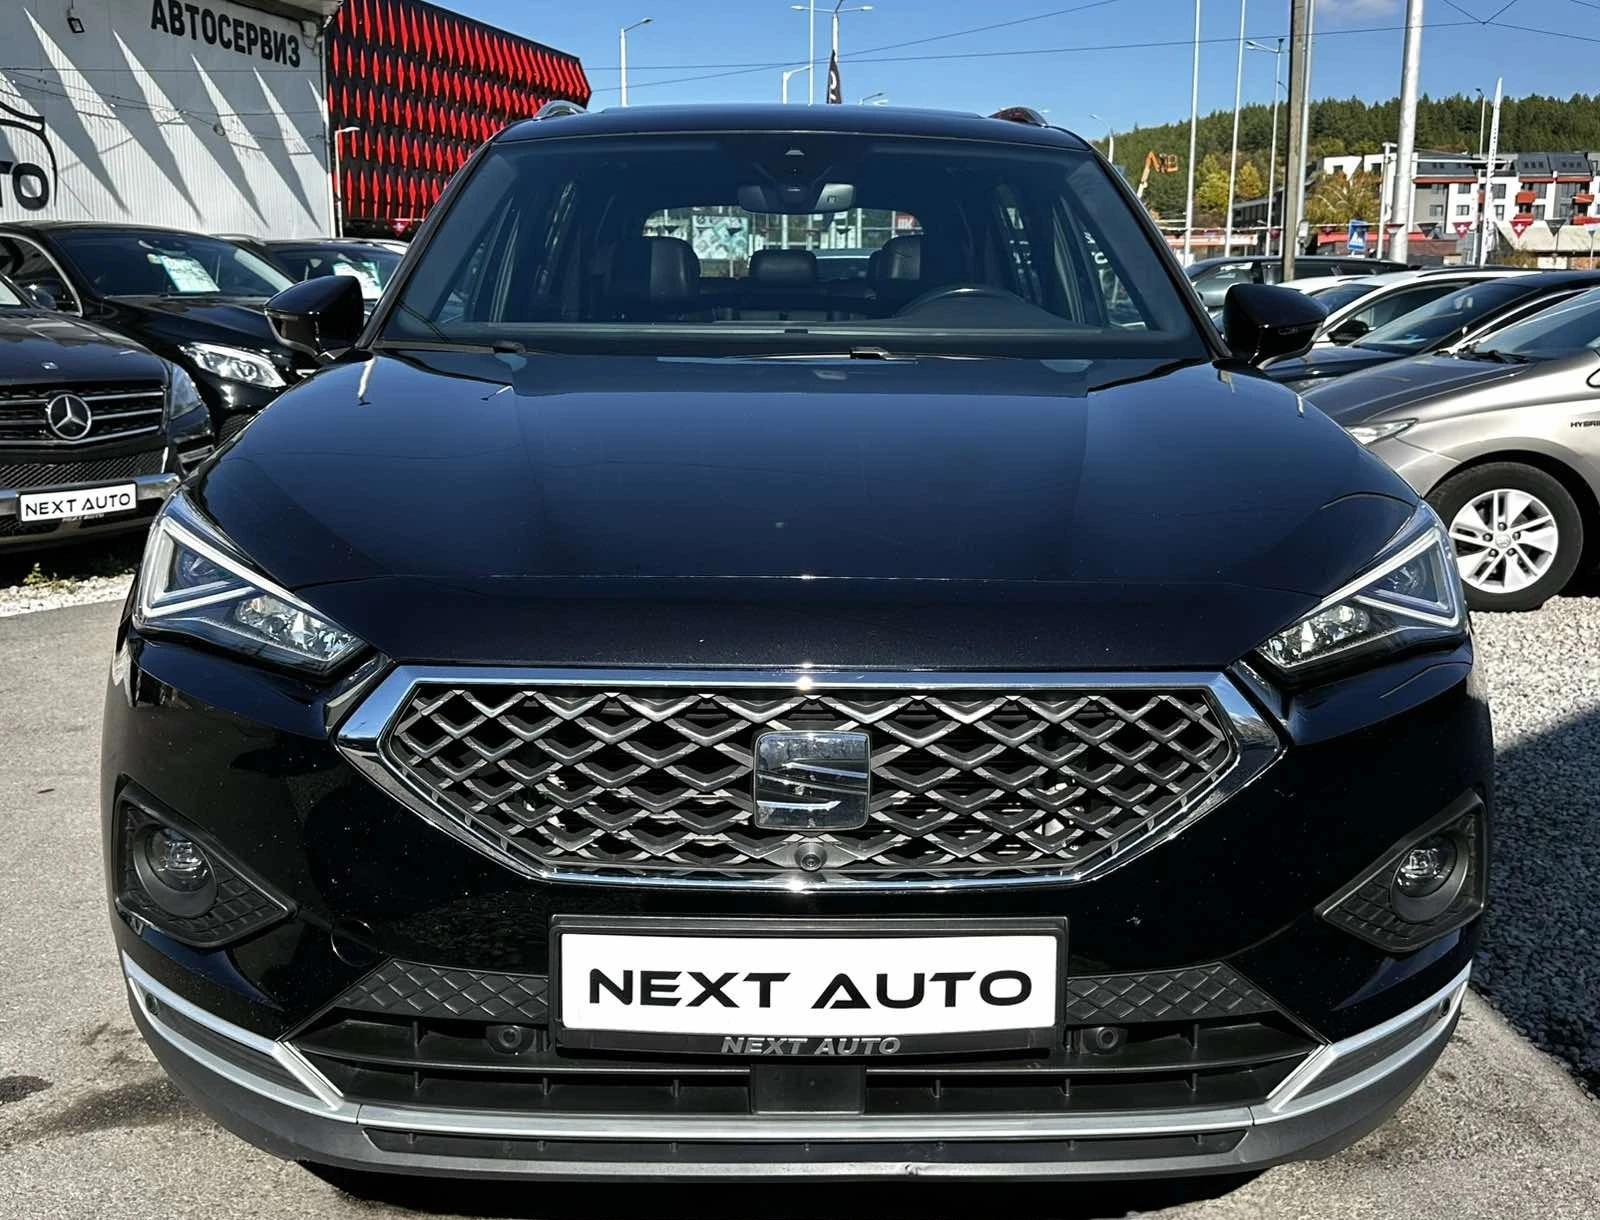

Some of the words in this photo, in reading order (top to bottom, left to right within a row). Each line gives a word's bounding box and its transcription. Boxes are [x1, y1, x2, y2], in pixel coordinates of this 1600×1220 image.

[151, 0, 300, 68] АВТОСЕРВИЗ
[25, 499, 77, 517] NEXT
[81, 493, 131, 511] AUTO
[589, 968, 791, 1009] NEXT
[810, 969, 1032, 1010] AUTO
[721, 1036, 808, 1055] NEXT
[814, 1036, 901, 1055] AUTO
